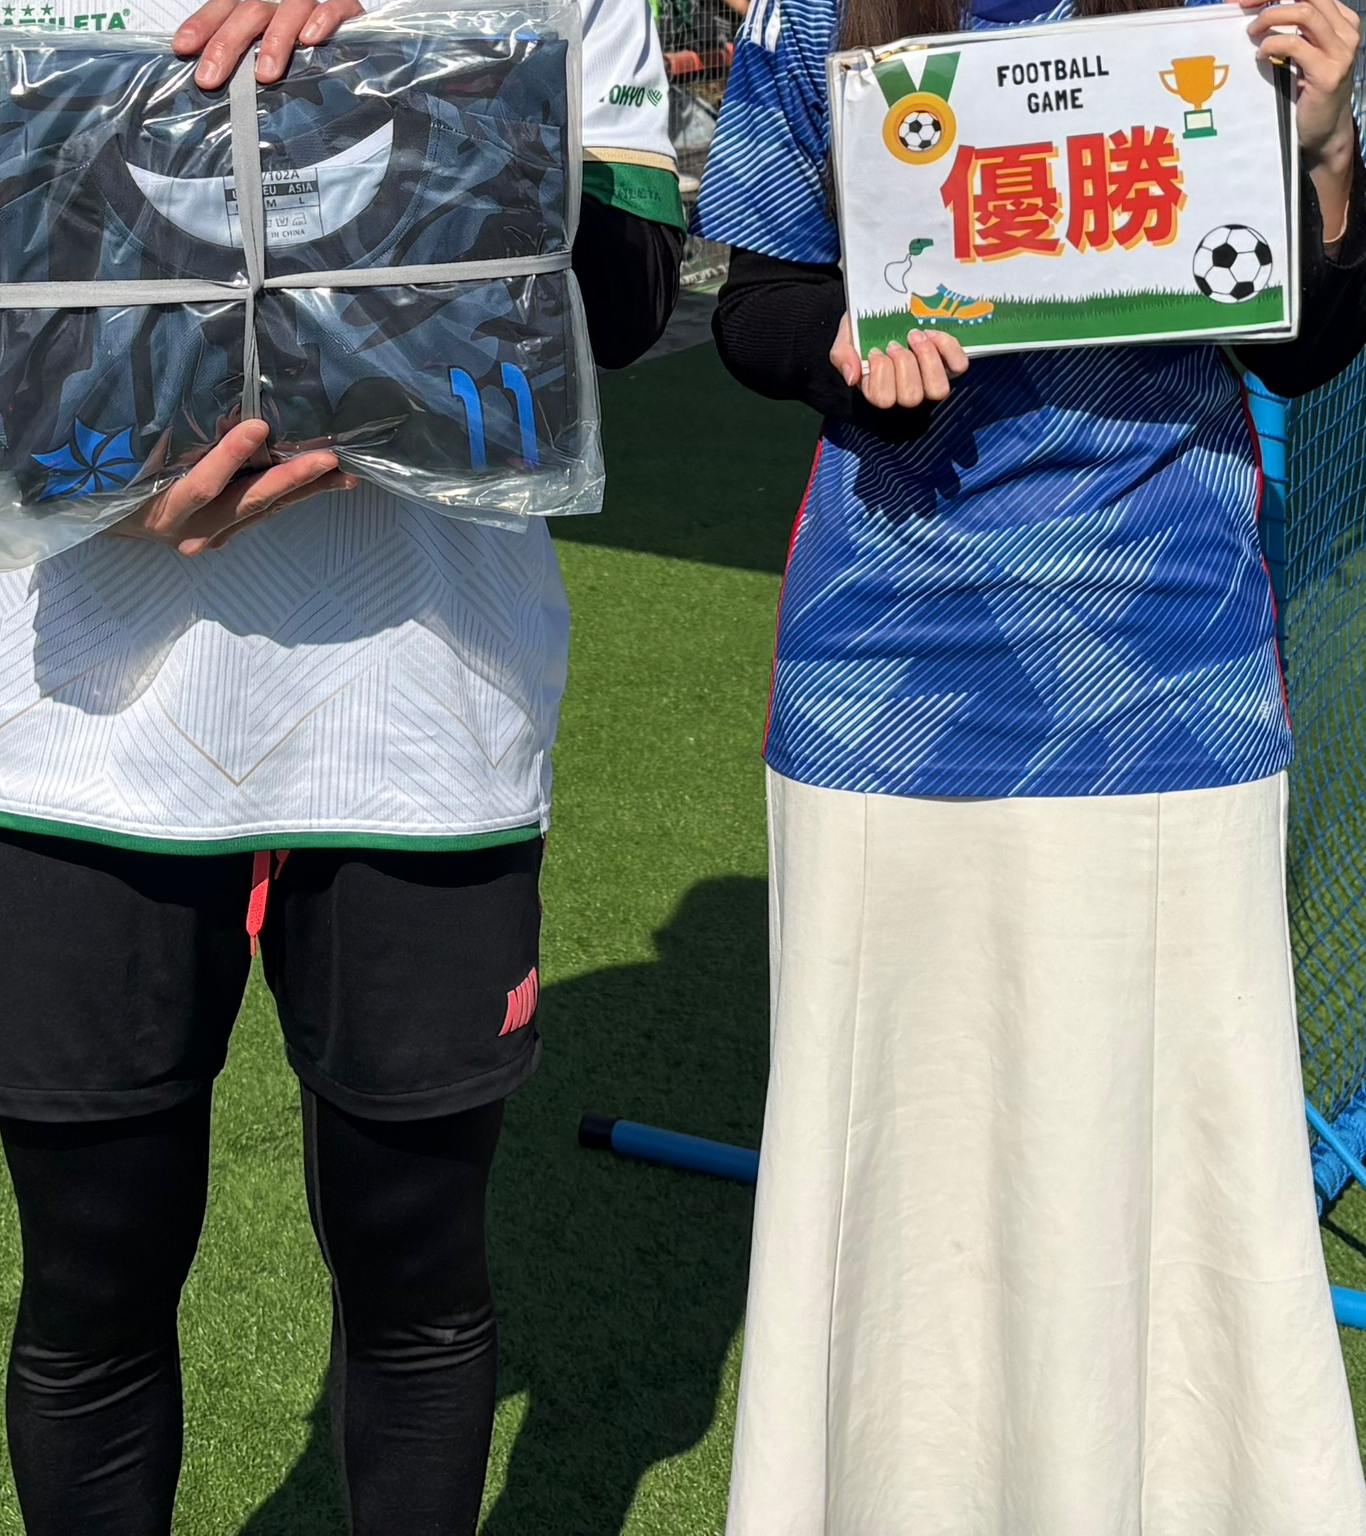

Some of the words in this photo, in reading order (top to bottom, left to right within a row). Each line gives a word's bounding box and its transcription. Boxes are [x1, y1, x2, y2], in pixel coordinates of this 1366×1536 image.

[997, 55, 1109, 87] FOOTBALL
[599, 84, 646, 108] OKYO
[1027, 88, 1084, 114] GAME
[288, 183, 314, 194] ASIA
[940, 125, 1188, 263] 優勝
[266, 198, 277, 208] M
[298, 196, 305, 205] L
[282, 229, 306, 239] CHINA
[450, 362, 540, 473] 11
